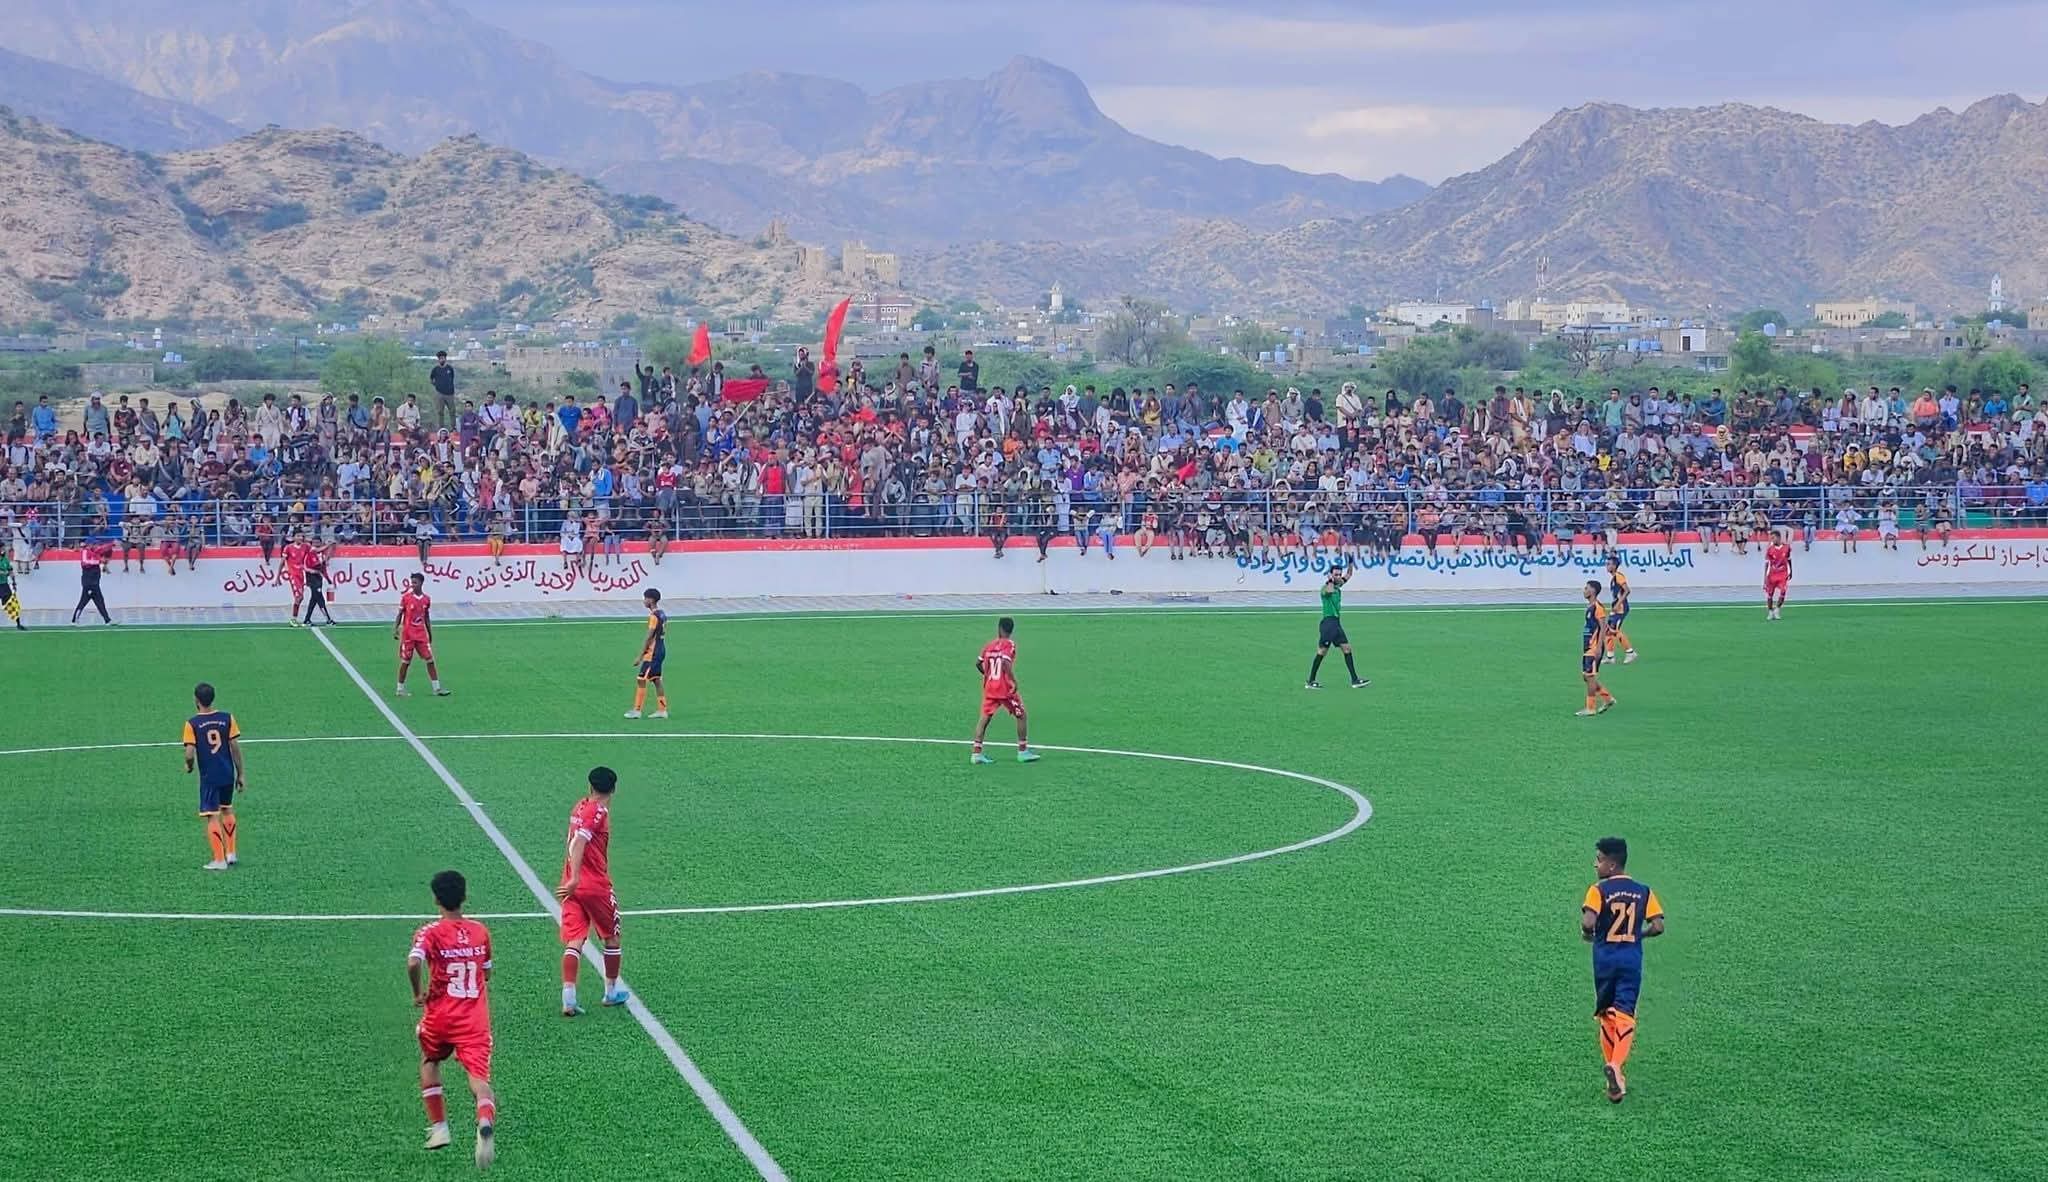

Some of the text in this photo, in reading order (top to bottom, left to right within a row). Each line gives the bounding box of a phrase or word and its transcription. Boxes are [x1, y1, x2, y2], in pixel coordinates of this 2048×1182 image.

[1632, 548, 1695, 573] الميدالية
[2000, 544, 2040, 568] إحراز
[356, 568, 398, 594] الذي
[424, 561, 461, 582] عليه
[500, 561, 536, 587] الذي
[207, 729, 222, 754] 9
[1606, 902, 1636, 942] 21
[446, 961, 480, 999] 31
